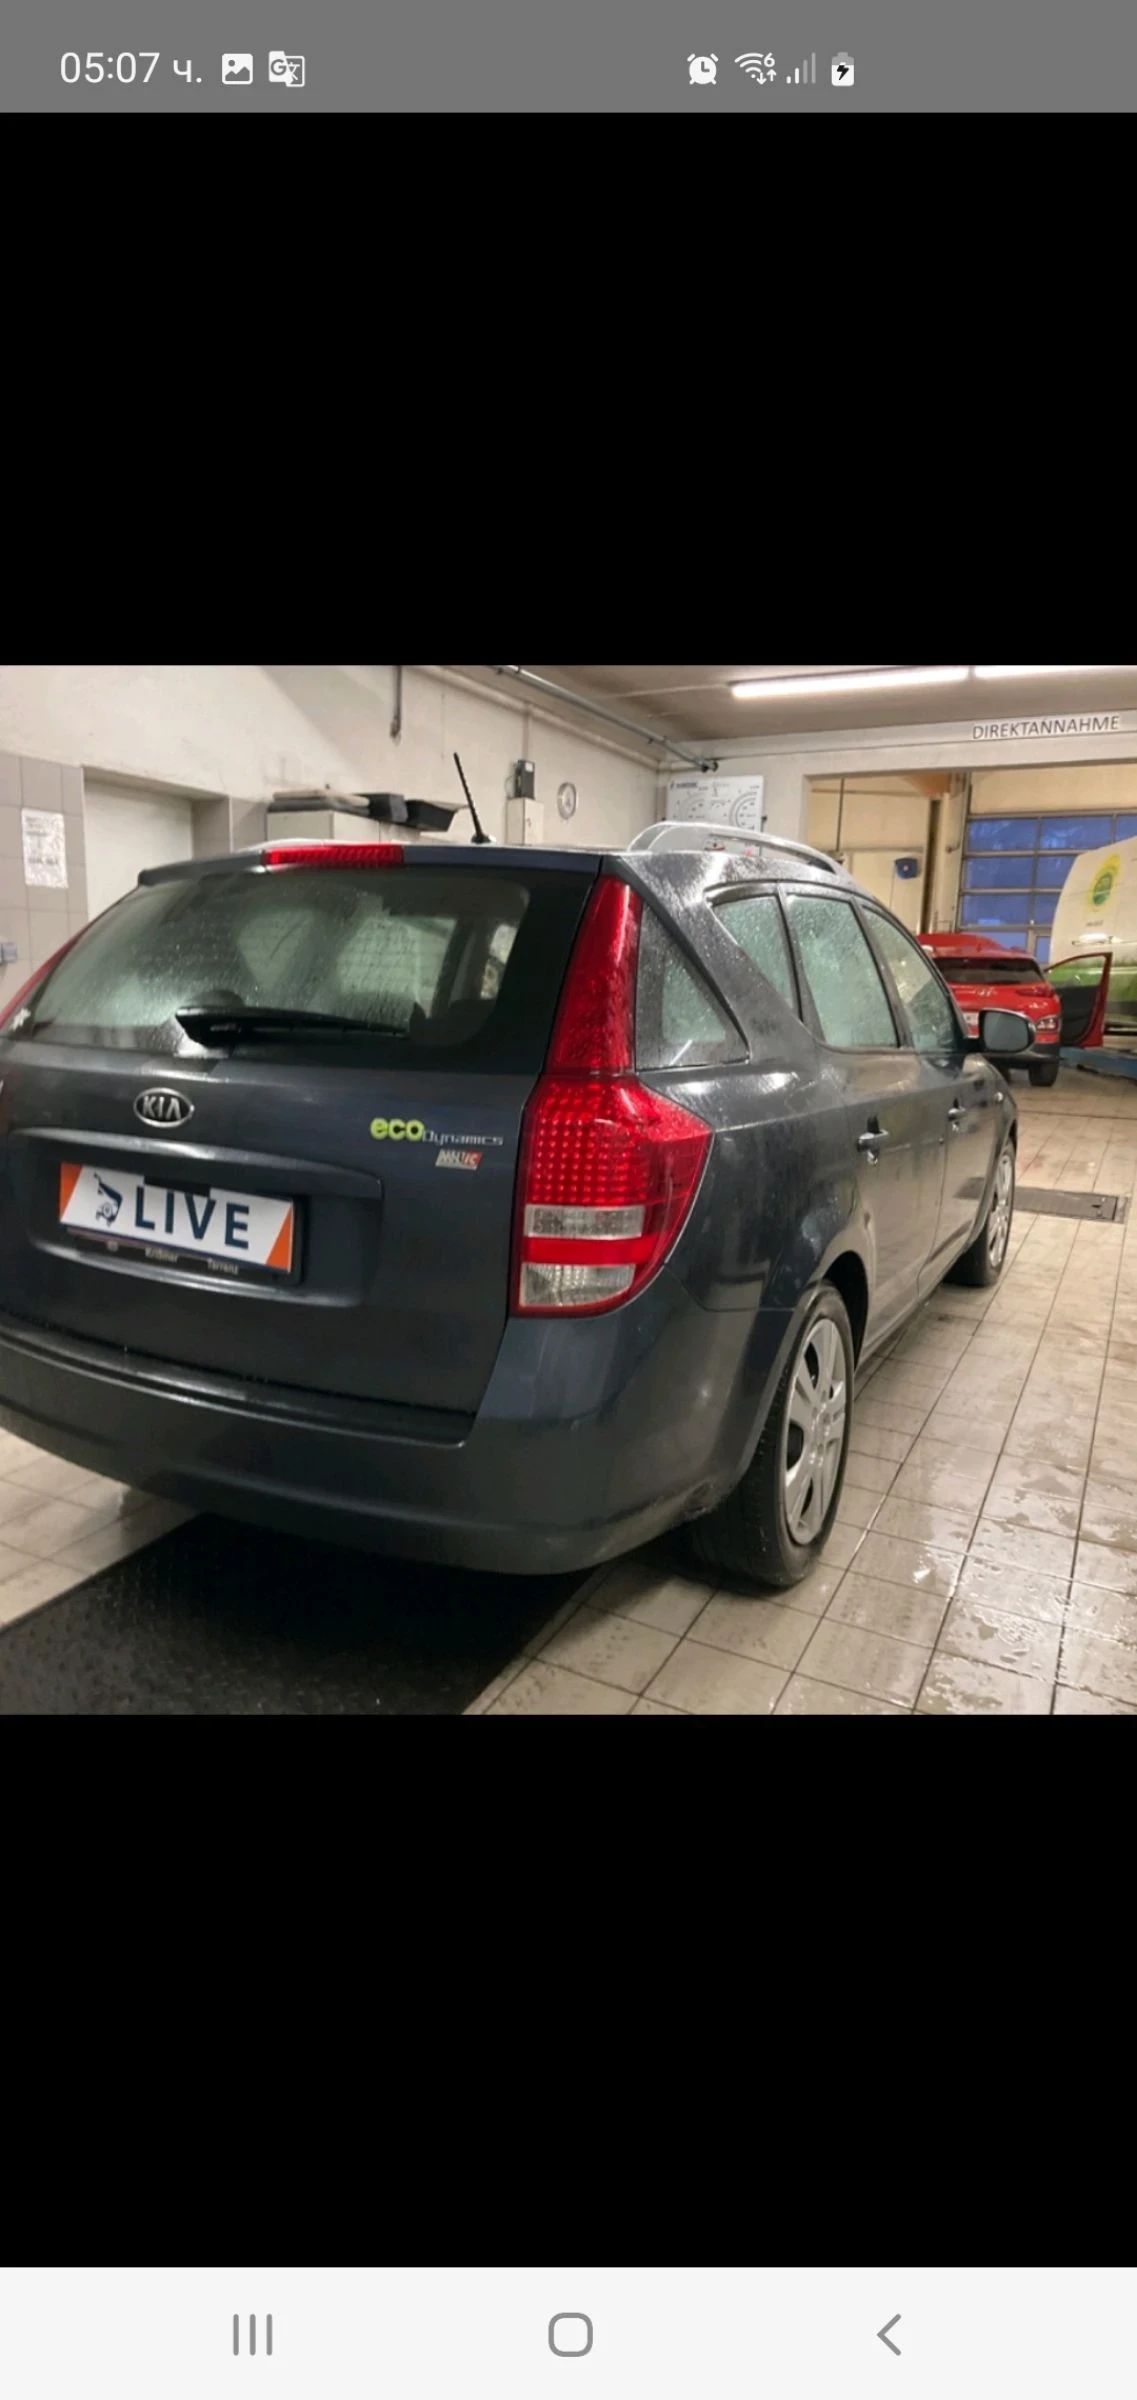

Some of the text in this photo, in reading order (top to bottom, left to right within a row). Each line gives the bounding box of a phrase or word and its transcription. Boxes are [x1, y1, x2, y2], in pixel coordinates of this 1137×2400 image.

[972, 715, 1120, 740] DIREKTANNAHME
[142, 1095, 182, 1120] KIA
[135, 1185, 250, 1249] LIVE
